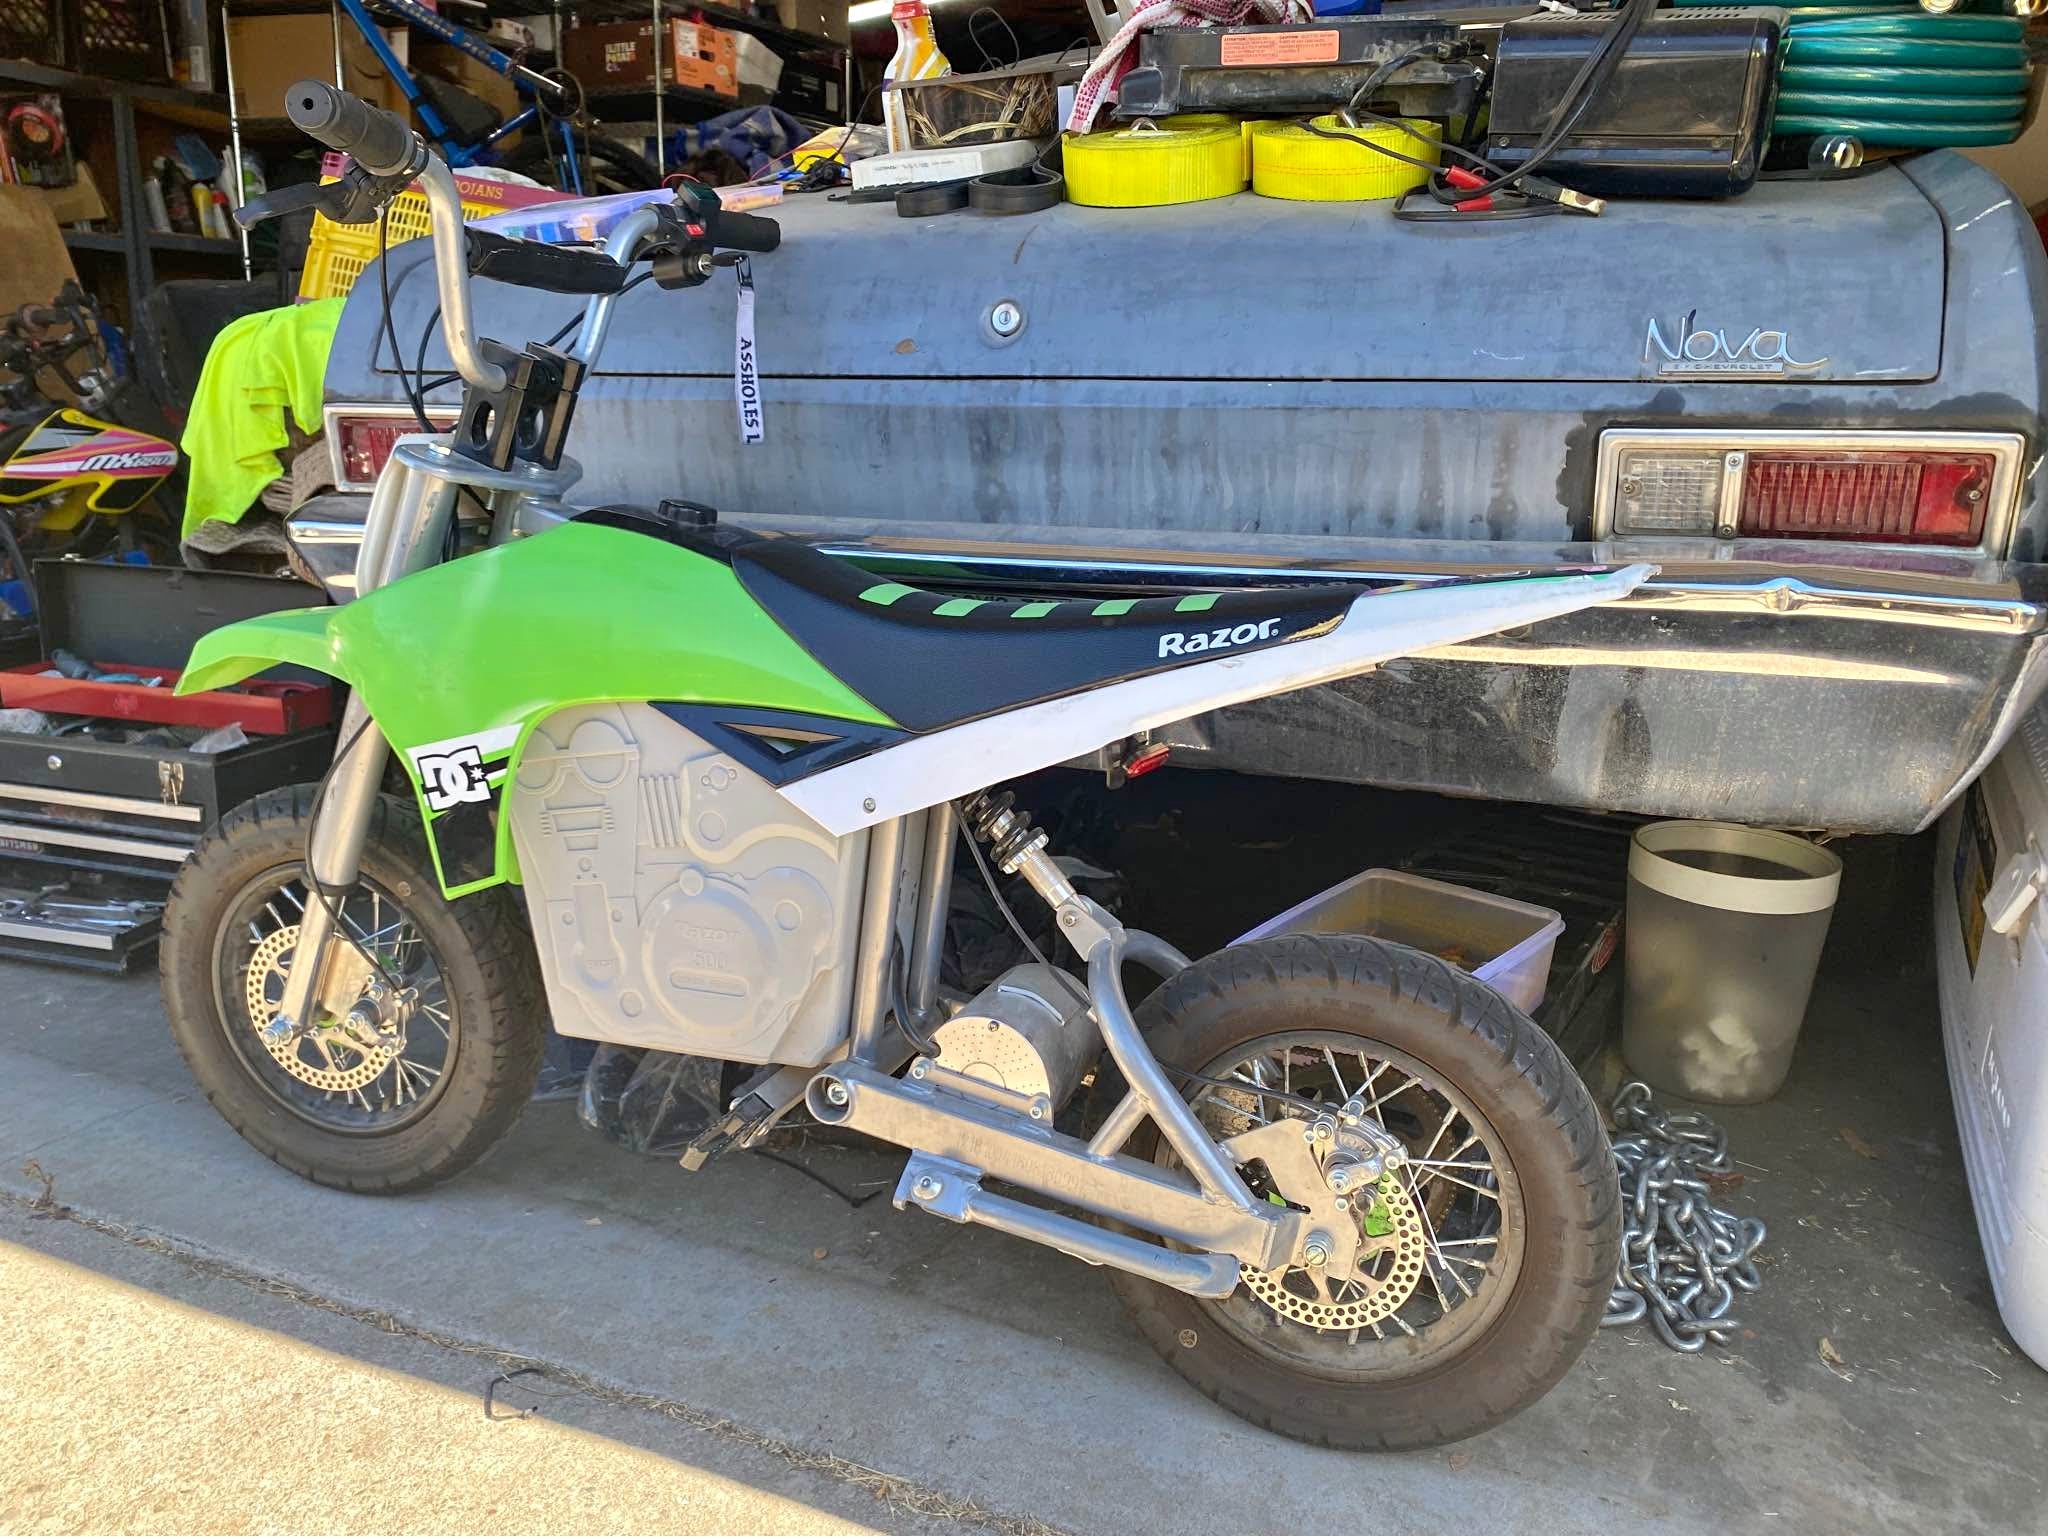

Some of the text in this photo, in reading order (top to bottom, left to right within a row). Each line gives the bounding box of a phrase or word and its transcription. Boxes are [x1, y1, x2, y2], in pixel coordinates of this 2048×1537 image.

[454, 182, 504, 200] OJANS
[1644, 316, 1828, 367] Nova
[740, 337, 760, 428] ASSHOLES
[1158, 617, 1281, 657] Razor
[417, 745, 491, 812] DC
